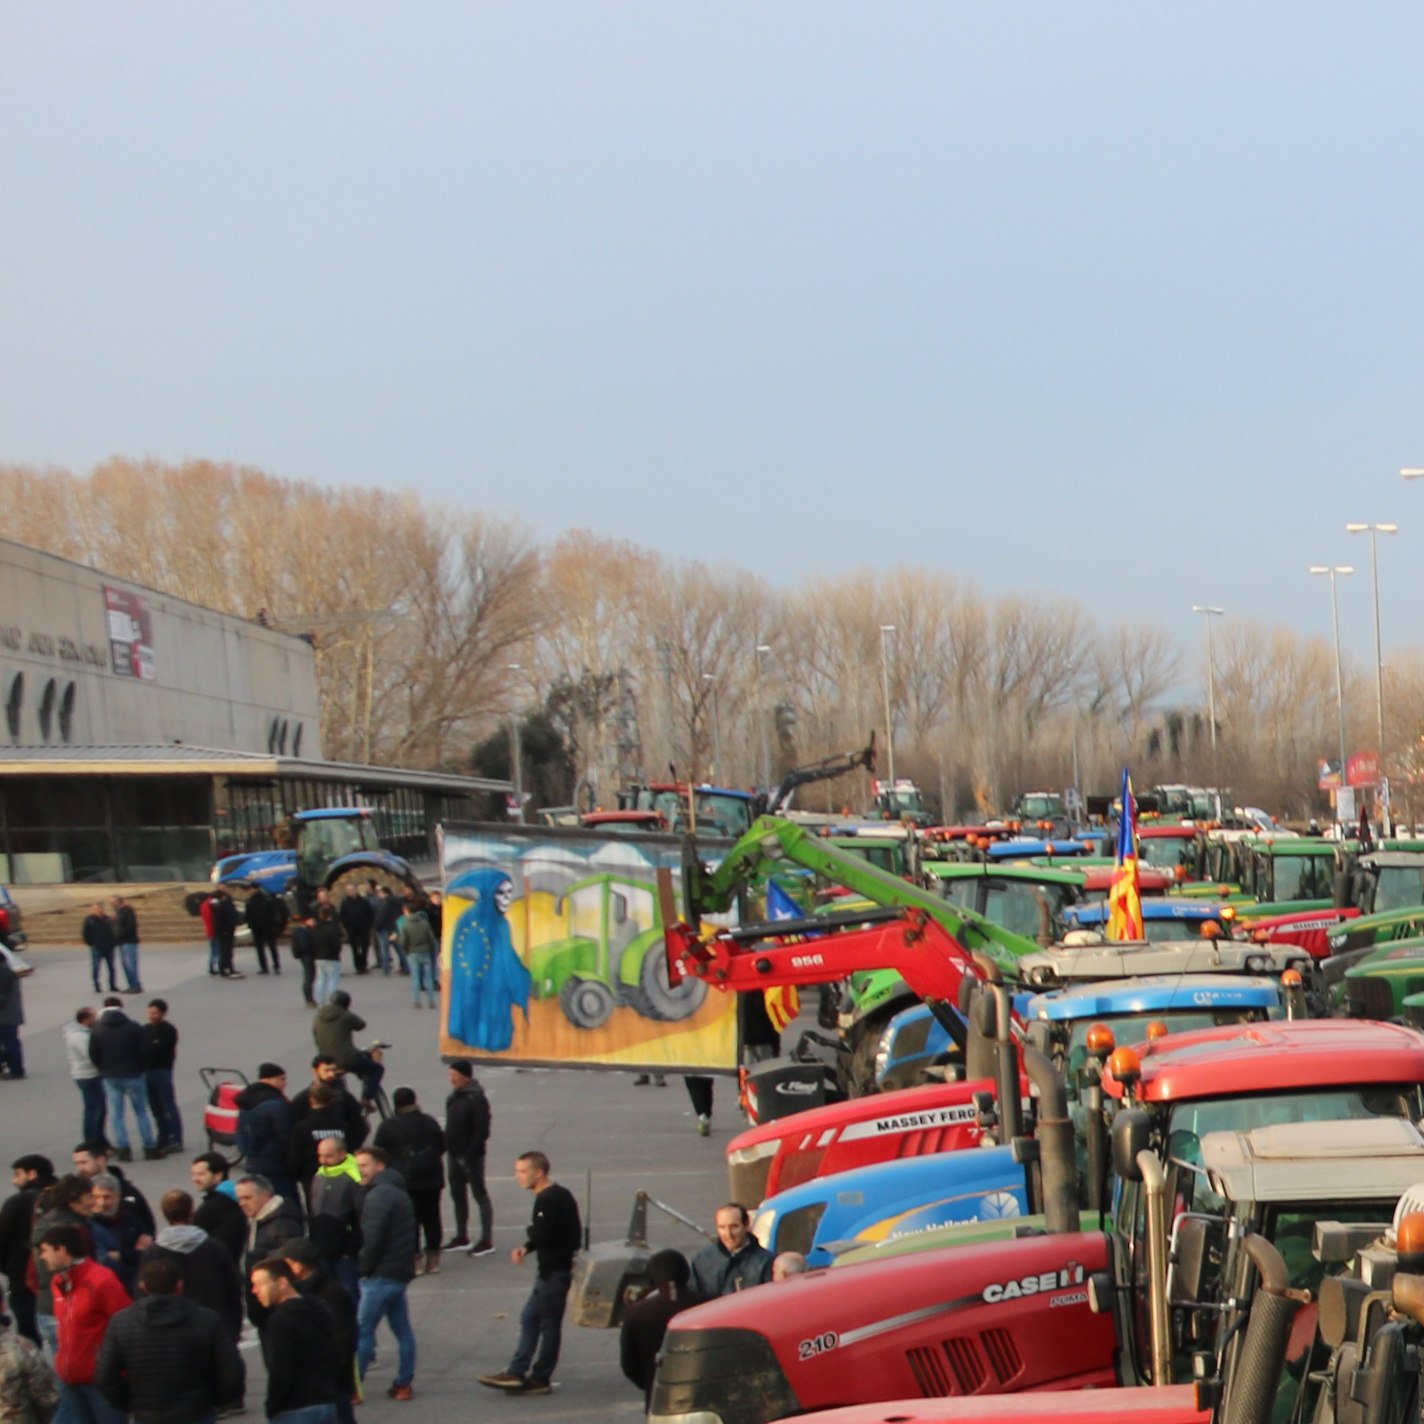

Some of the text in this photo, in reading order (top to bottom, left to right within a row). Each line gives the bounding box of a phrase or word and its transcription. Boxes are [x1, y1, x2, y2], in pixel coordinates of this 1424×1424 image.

[877, 1109, 976, 1132] MASSEY FERG
[982, 1272, 1057, 1304] CASE
[799, 1329, 838, 1361] 210
